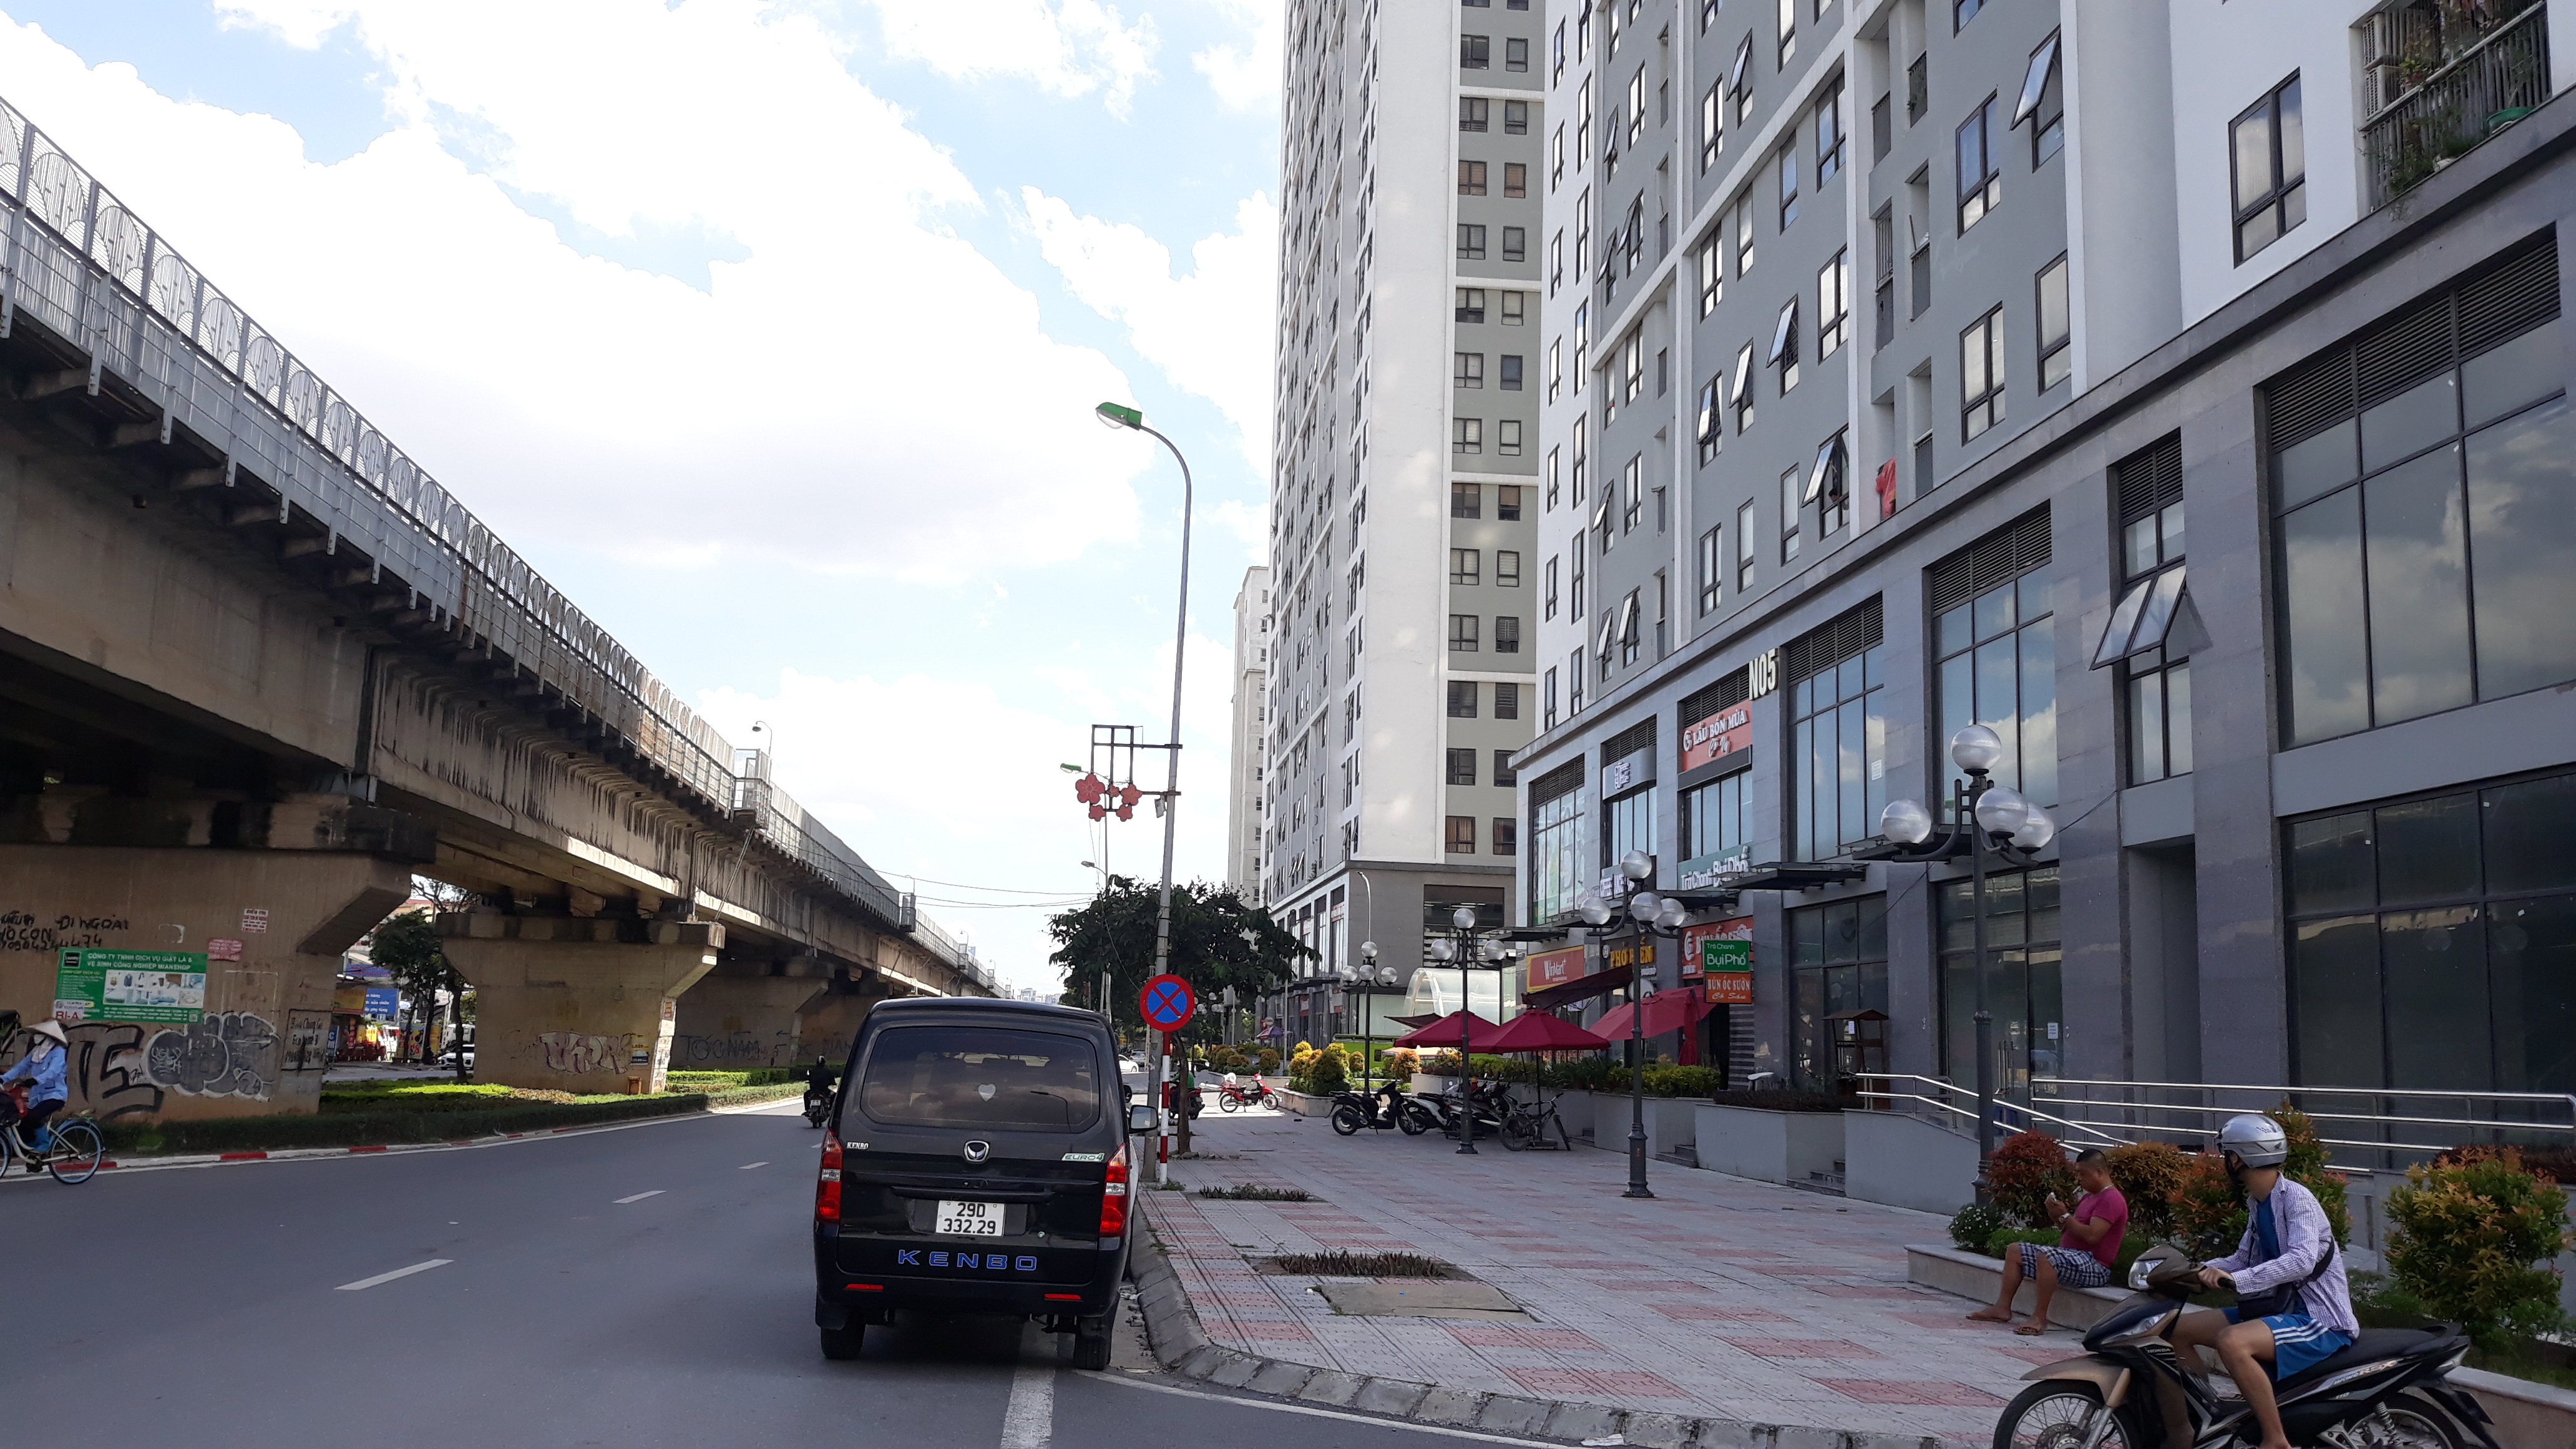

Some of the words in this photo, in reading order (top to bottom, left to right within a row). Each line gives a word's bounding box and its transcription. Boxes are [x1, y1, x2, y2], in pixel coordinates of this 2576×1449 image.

[1709, 714, 1728, 738] BỐN
[1728, 709, 1747, 729] MÙA
[1707, 976, 1720, 990] BÚN
[1723, 975, 1731, 990] ỐC
[847, 1141, 869, 1149] KENBO
[957, 1203, 986, 1217] 29D
[943, 1218, 997, 1234] 332.29
[898, 1249, 1038, 1271] KENBO
